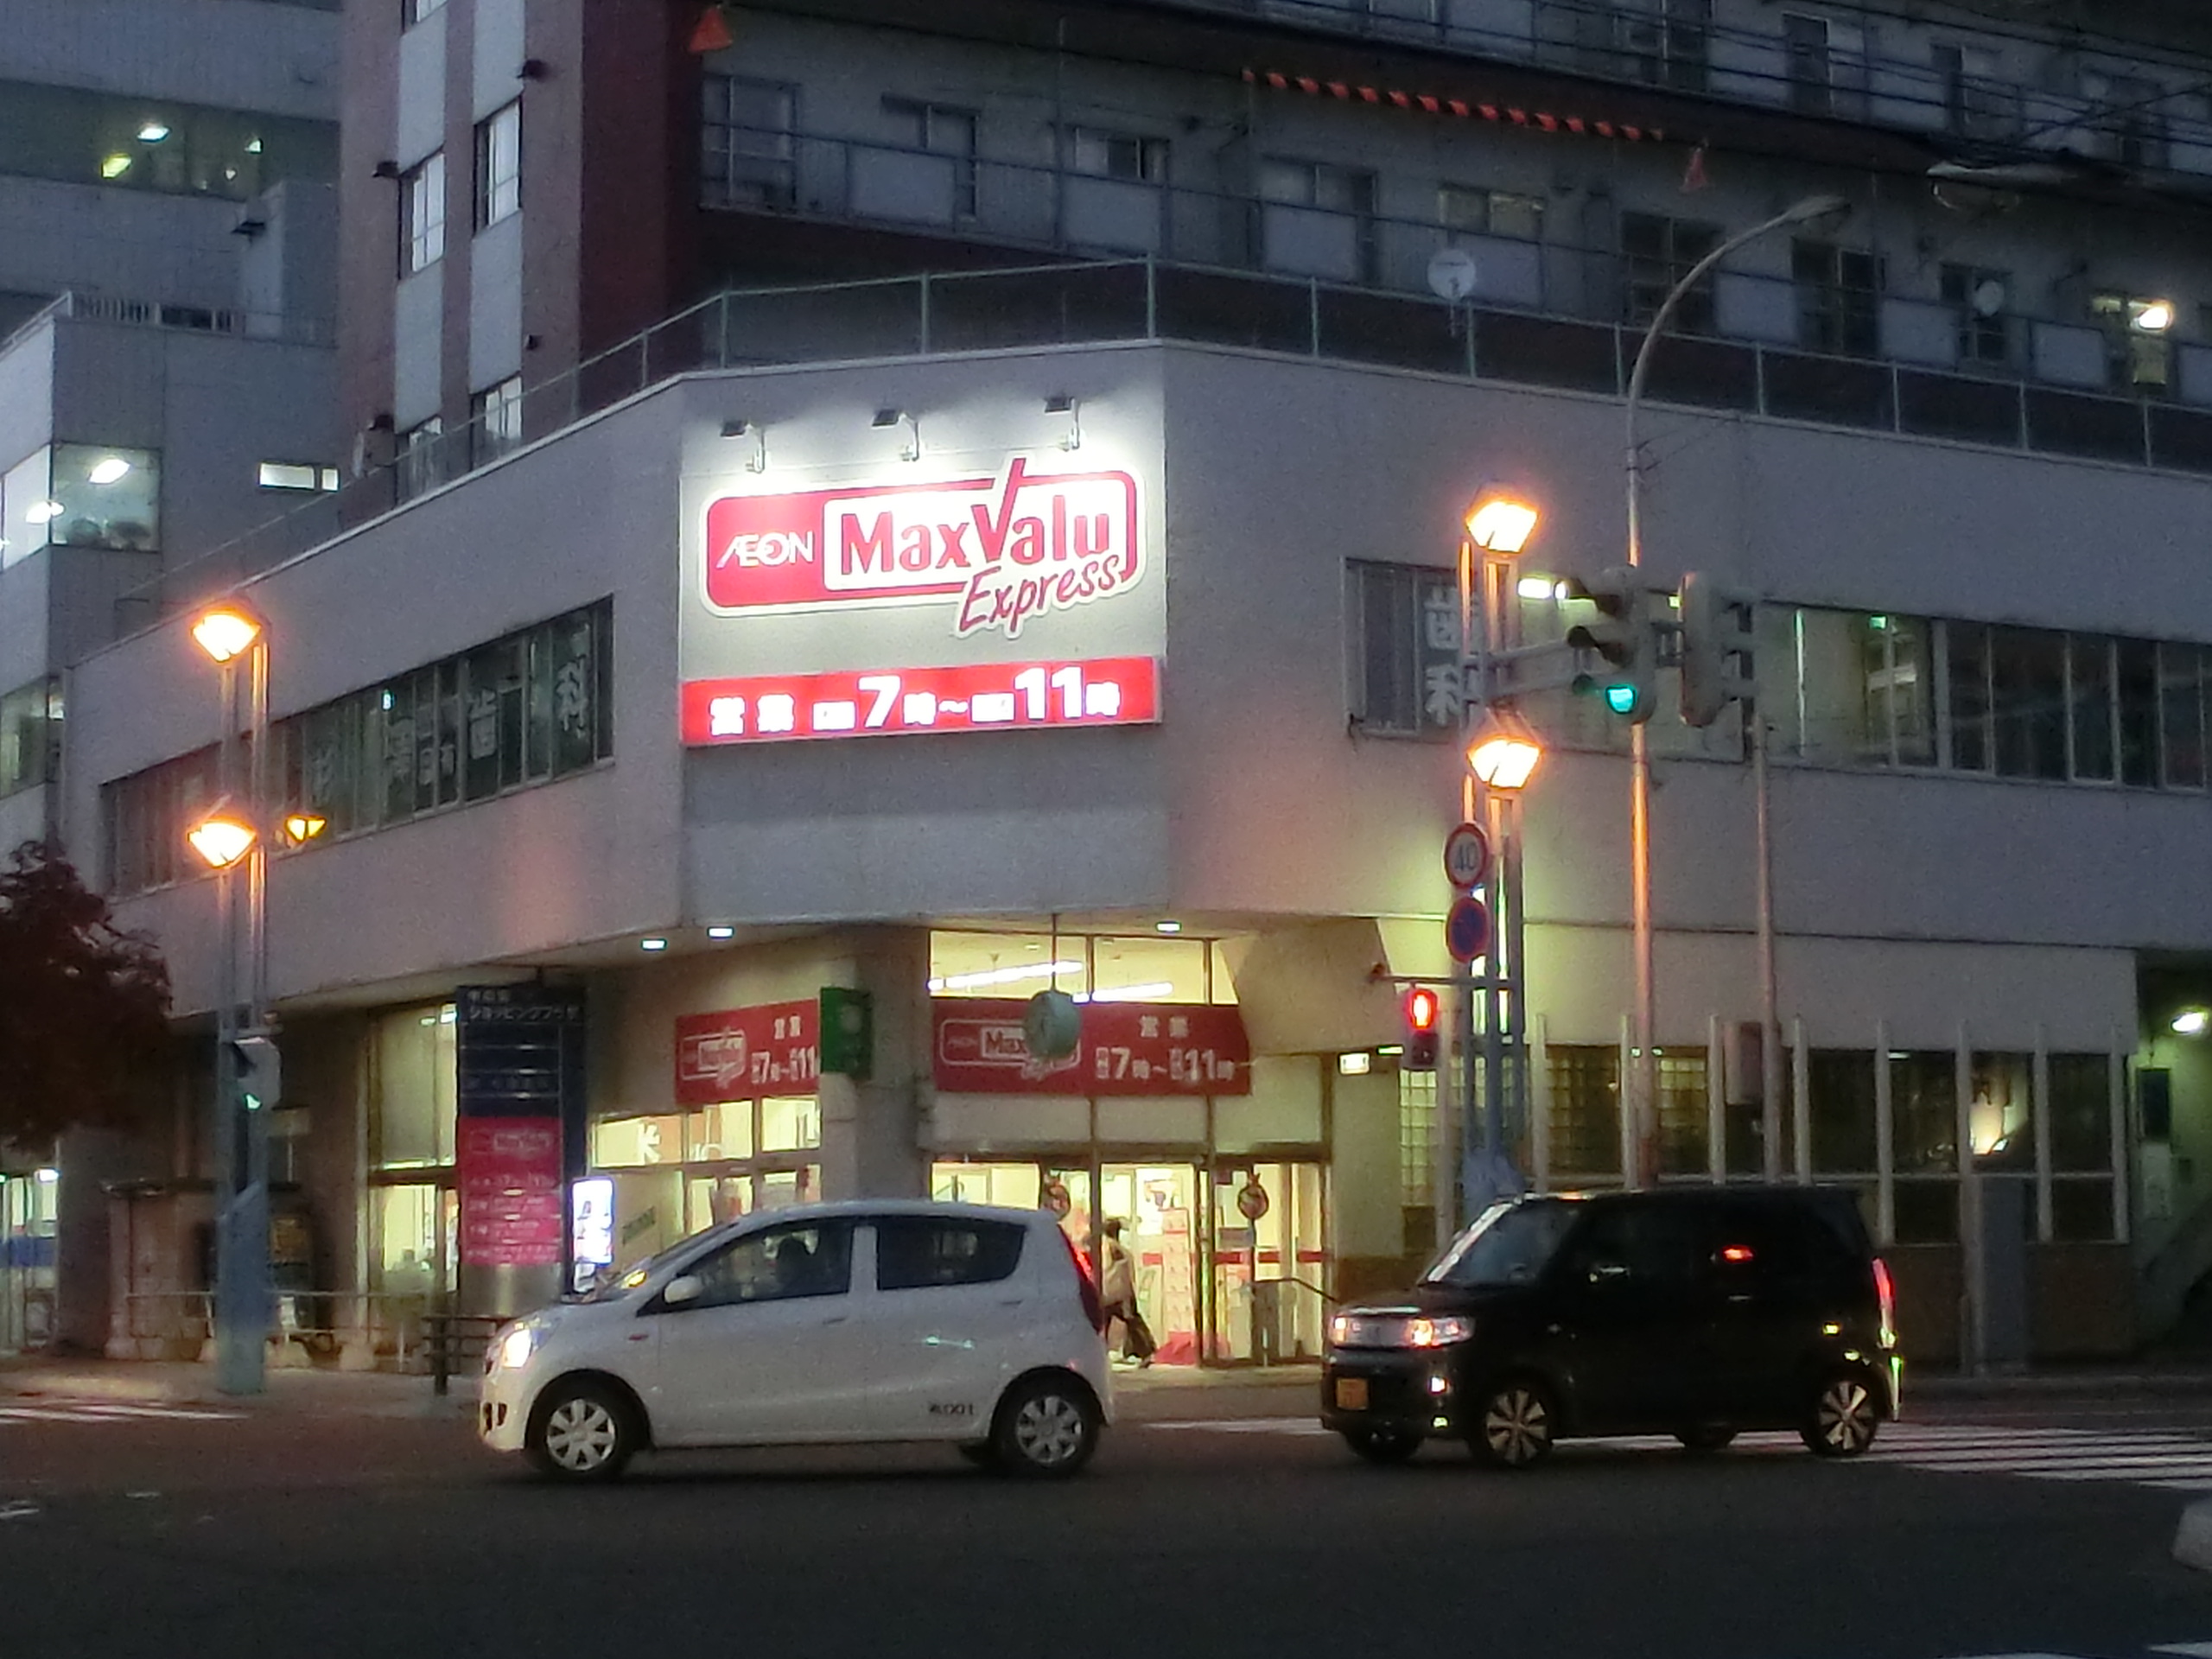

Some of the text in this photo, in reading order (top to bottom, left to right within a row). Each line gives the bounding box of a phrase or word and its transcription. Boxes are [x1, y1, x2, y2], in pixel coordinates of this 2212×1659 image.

[841, 458, 1110, 576] MaxValu
[958, 553, 1121, 632] Express
[1453, 842, 1478, 871] 40
